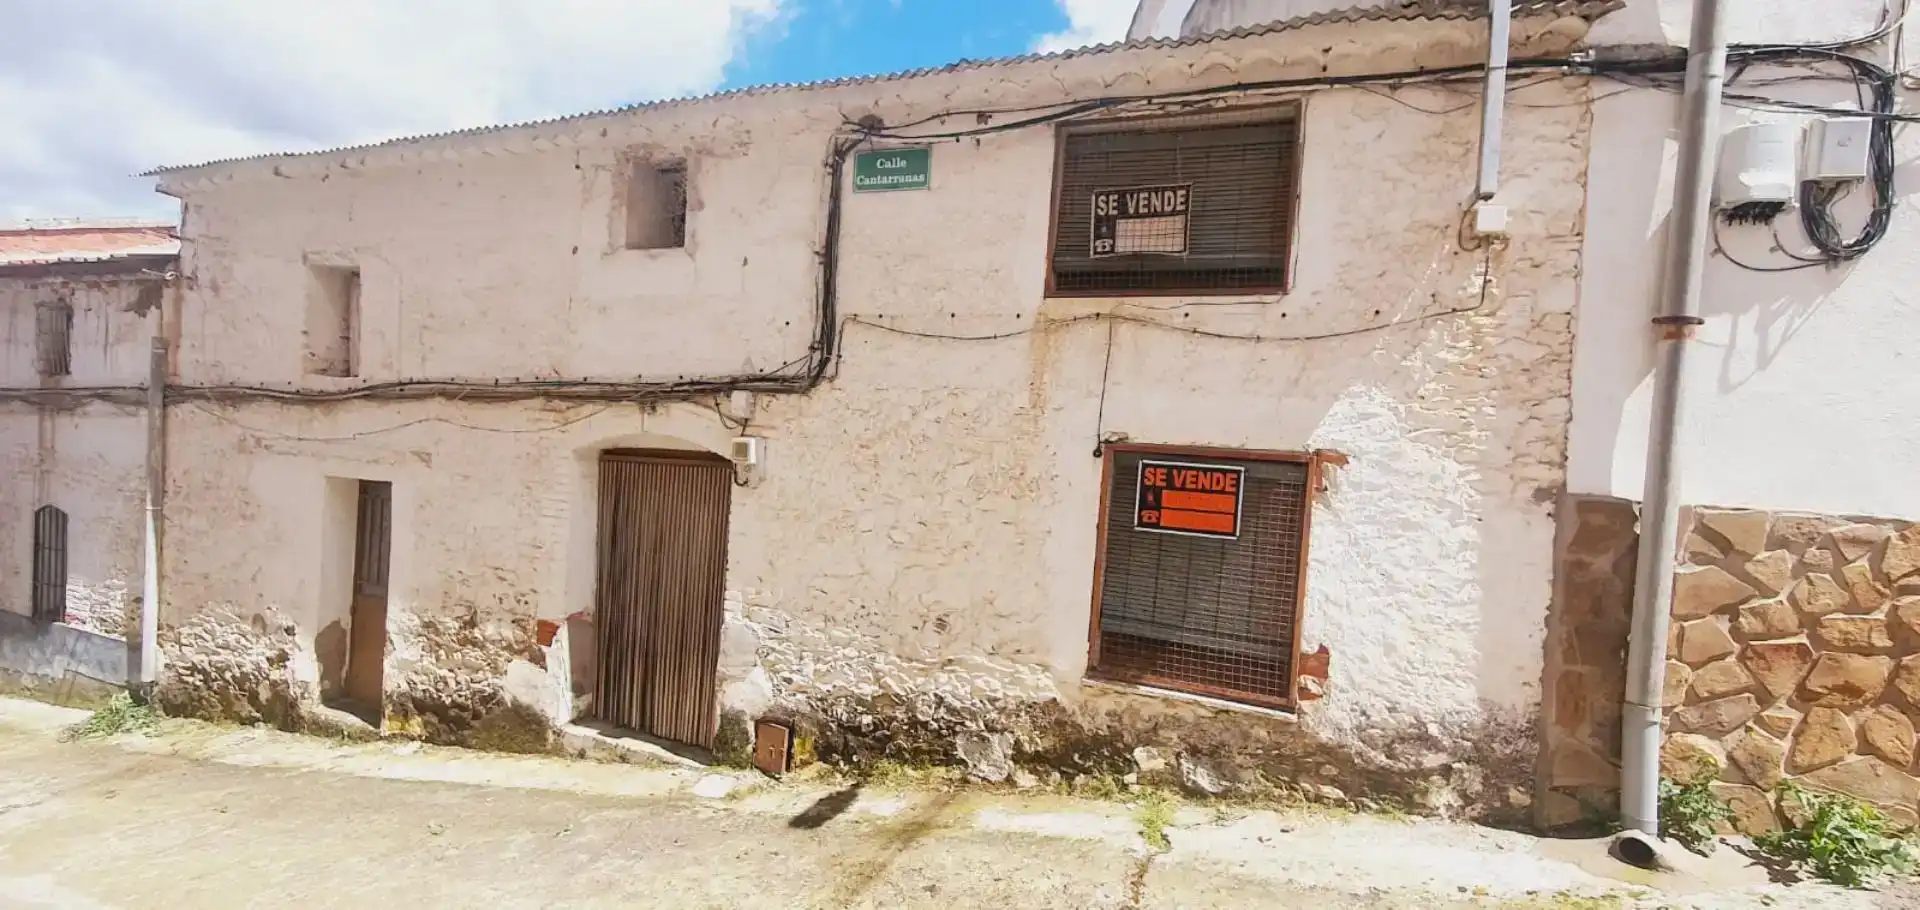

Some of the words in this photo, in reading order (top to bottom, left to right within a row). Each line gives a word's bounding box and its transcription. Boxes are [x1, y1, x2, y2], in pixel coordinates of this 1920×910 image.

[876, 157, 907, 169] Calle
[856, 174, 926, 186] Cantarranas
[1096, 194, 1119, 216] SE
[1126, 190, 1187, 215] VENDE
[1143, 467, 1167, 487] SE
[1172, 469, 1238, 492] VENDE
